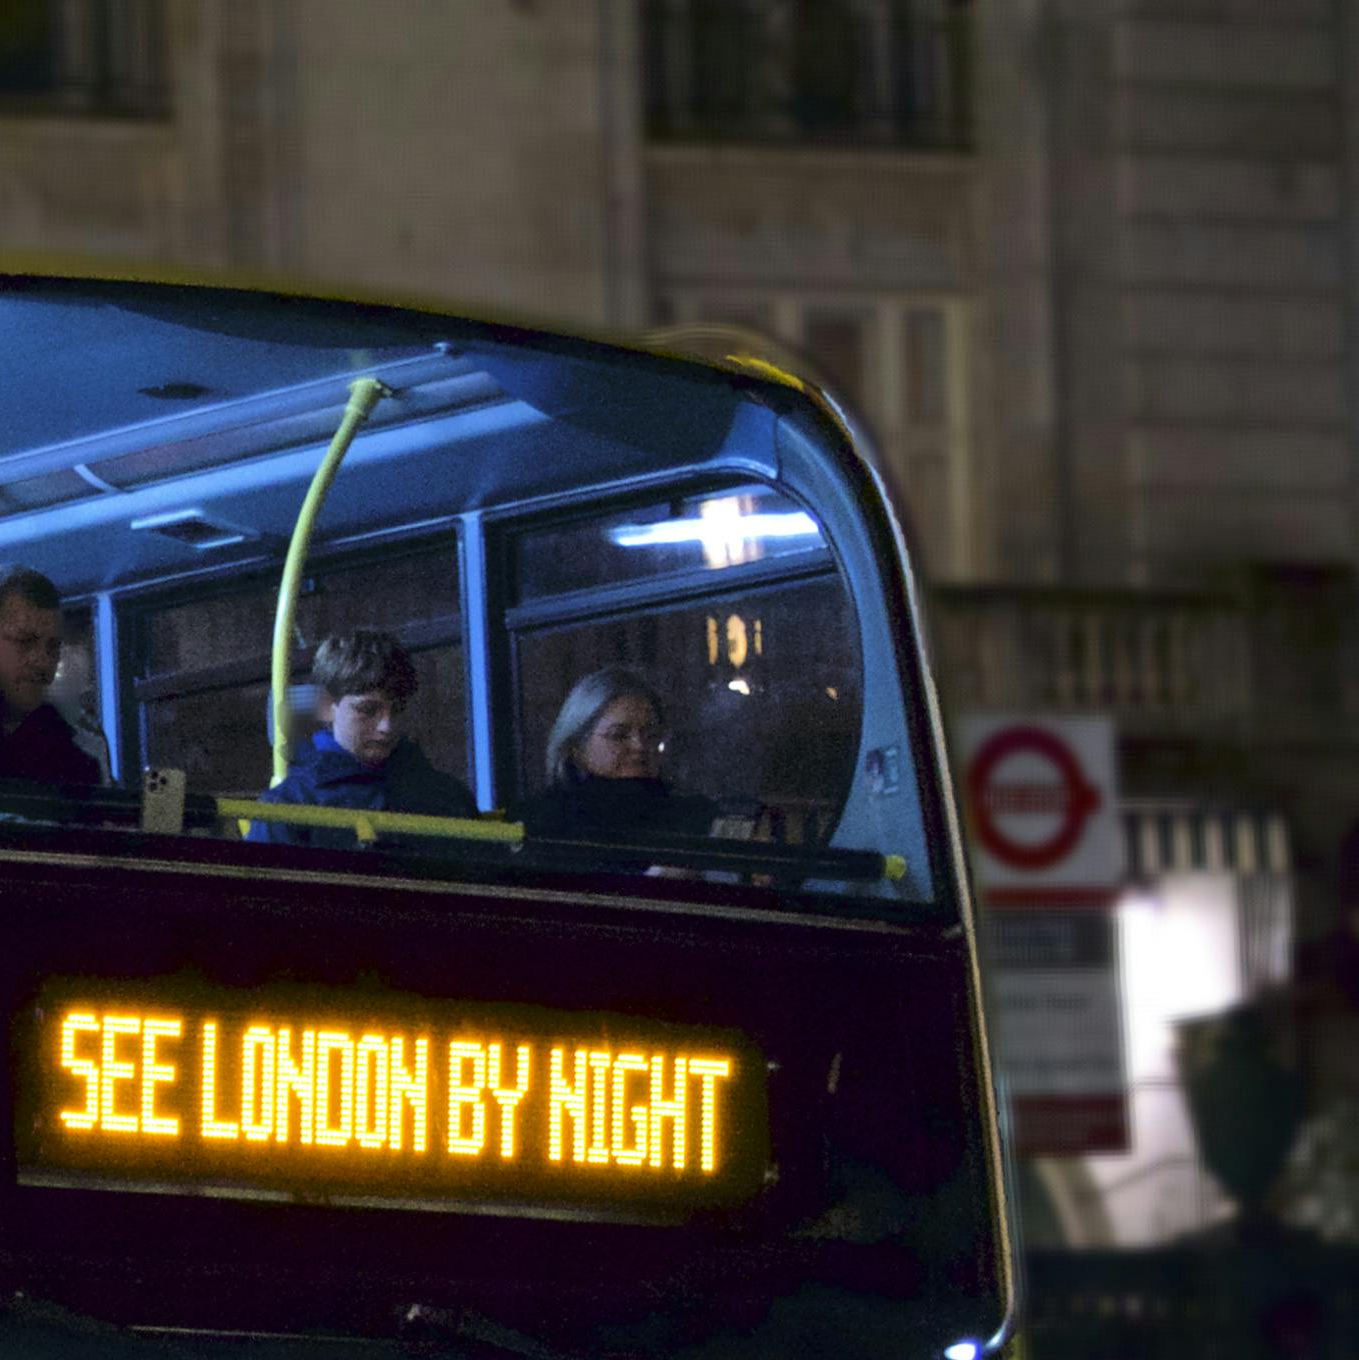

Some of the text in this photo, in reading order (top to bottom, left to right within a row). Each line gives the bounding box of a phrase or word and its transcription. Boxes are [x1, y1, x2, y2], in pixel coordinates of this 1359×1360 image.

[59, 1012, 731, 1172] SEE LONDON BY NIGHT
